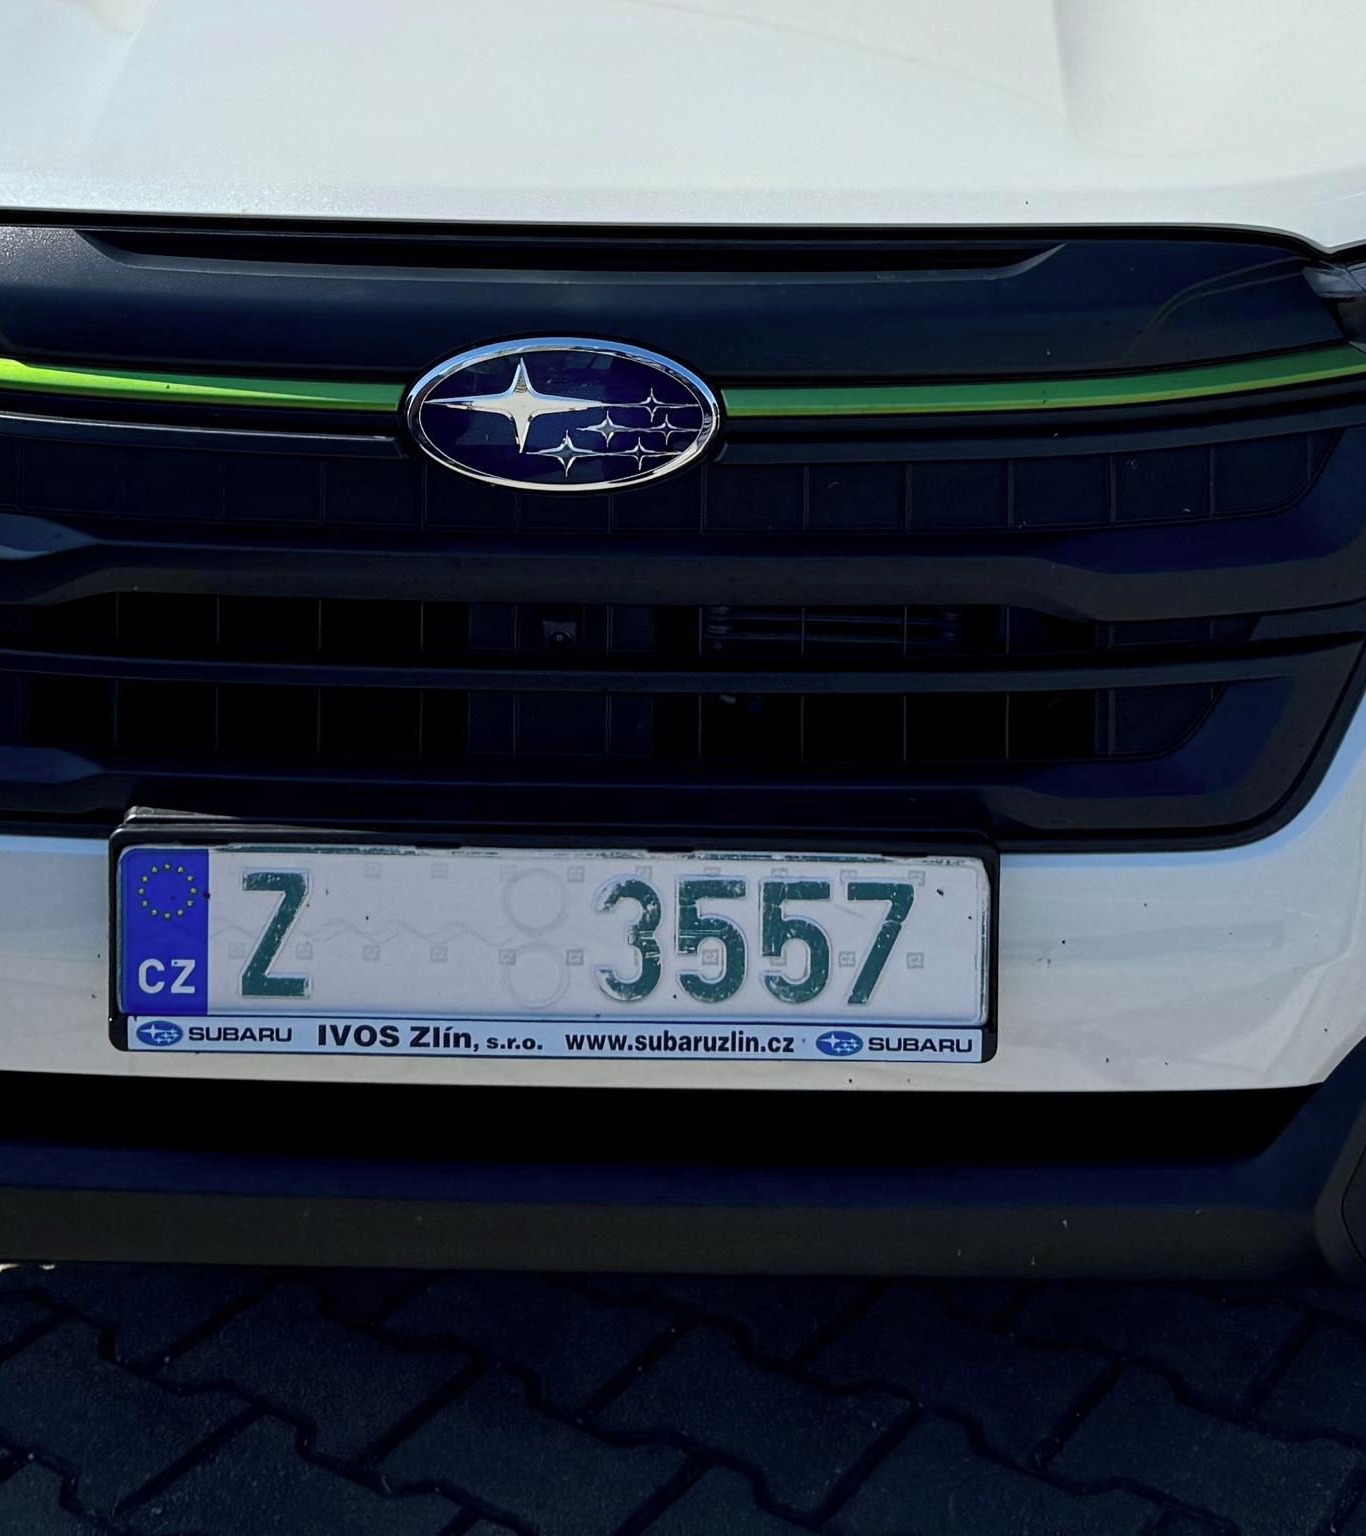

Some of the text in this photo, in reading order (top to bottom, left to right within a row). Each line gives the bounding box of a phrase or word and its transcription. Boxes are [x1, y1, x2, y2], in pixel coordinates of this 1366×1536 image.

[241, 871, 915, 1005] Z 3557
[138, 958, 196, 995] CZ
[188, 1024, 973, 1054] SUBARU IVOS Zlín, s.r.o. www.subaruzlin.cz SUBARU
